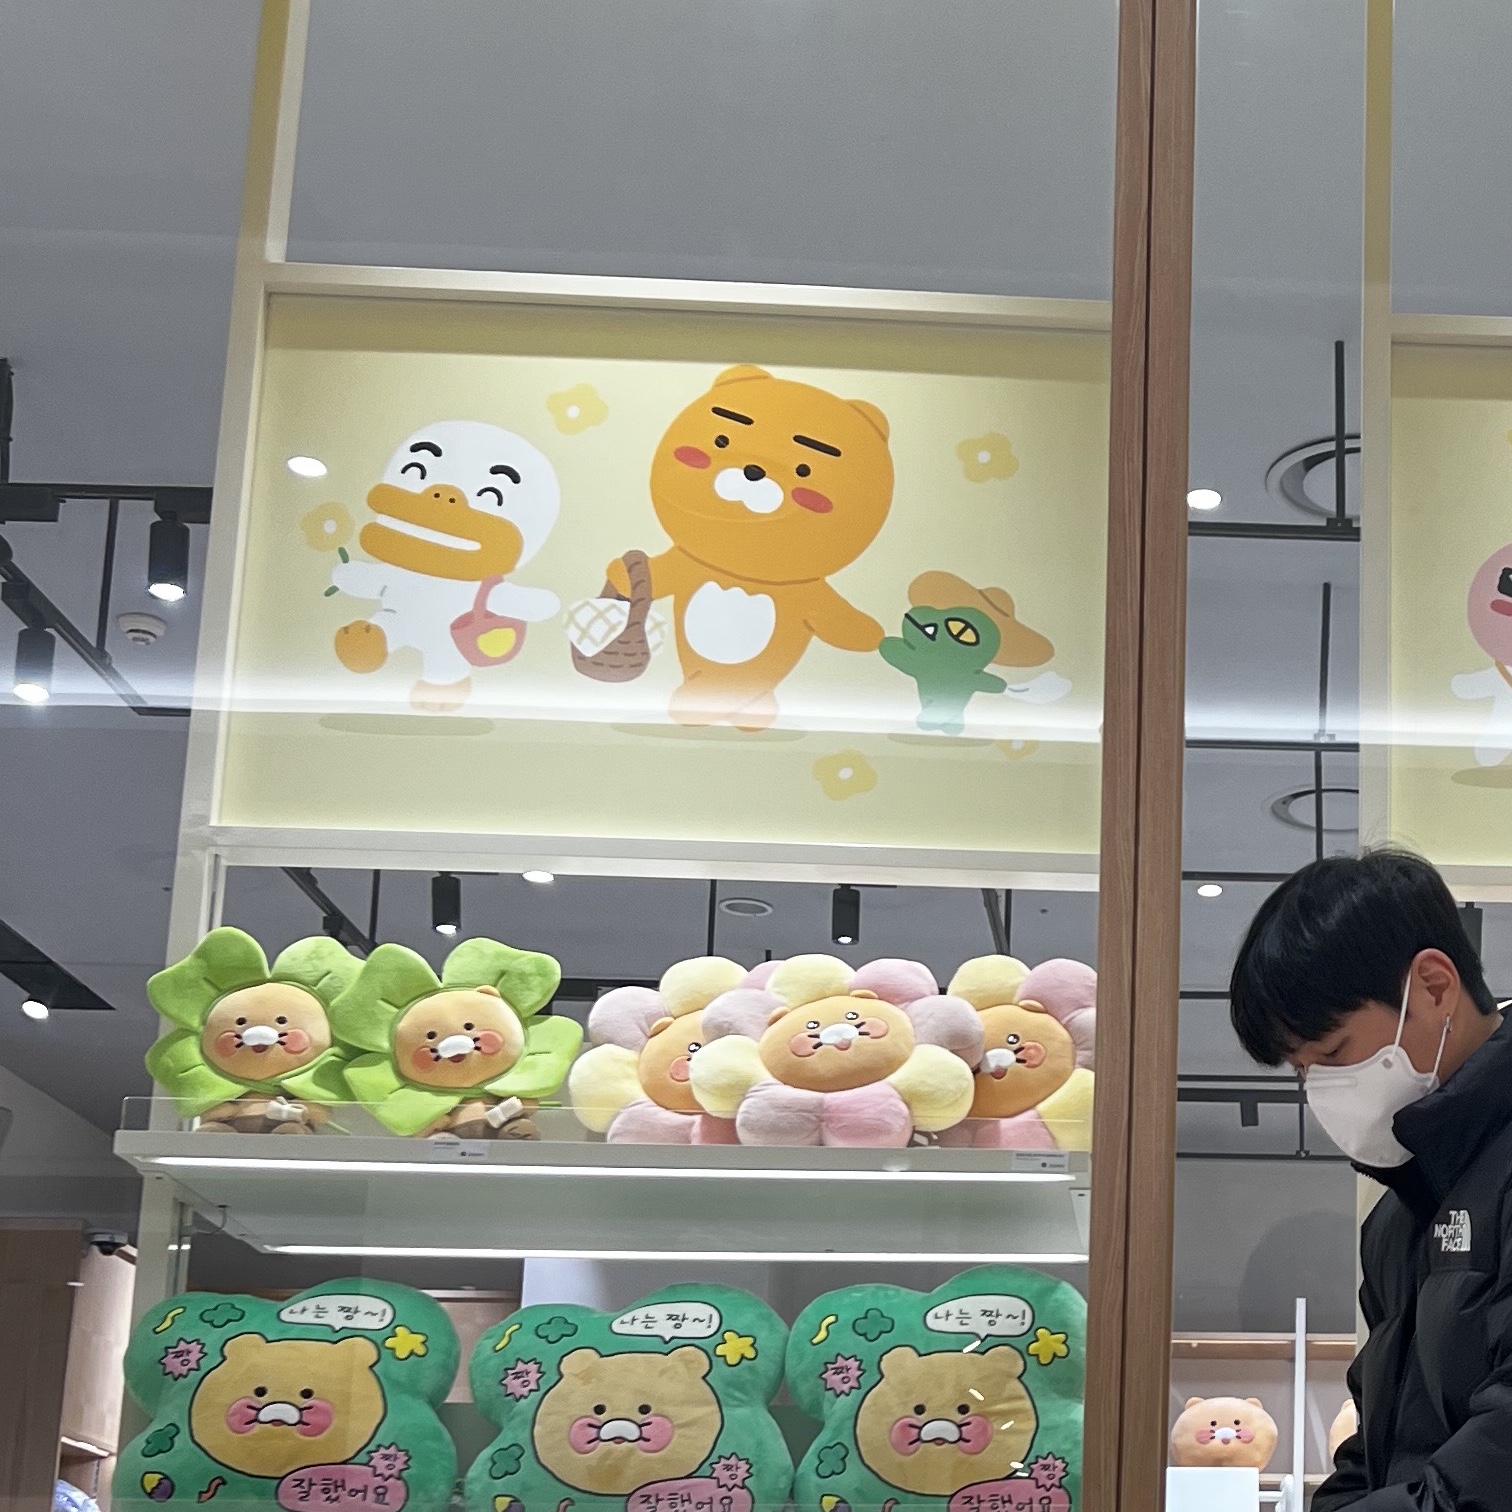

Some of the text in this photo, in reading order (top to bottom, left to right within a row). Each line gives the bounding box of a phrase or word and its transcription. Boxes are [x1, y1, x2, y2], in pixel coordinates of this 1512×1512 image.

[1449, 1210, 1466, 1224] THE
[1433, 1224, 1464, 1238] NORTH
[1441, 1238, 1463, 1251] FACE
[288, 1303, 329, 1319] 나는
[934, 1308, 972, 1326] 나는
[620, 1313, 657, 1329] 나는
[170, 1350, 192, 1367] 짱
[511, 1369, 531, 1388] 짱
[830, 1365, 851, 1385] 짱
[379, 1453, 398, 1471] 짱
[722, 1463, 741, 1481] 짱
[1039, 1463, 1058, 1481] 짱
[291, 1476, 390, 1506] 잘했어요
